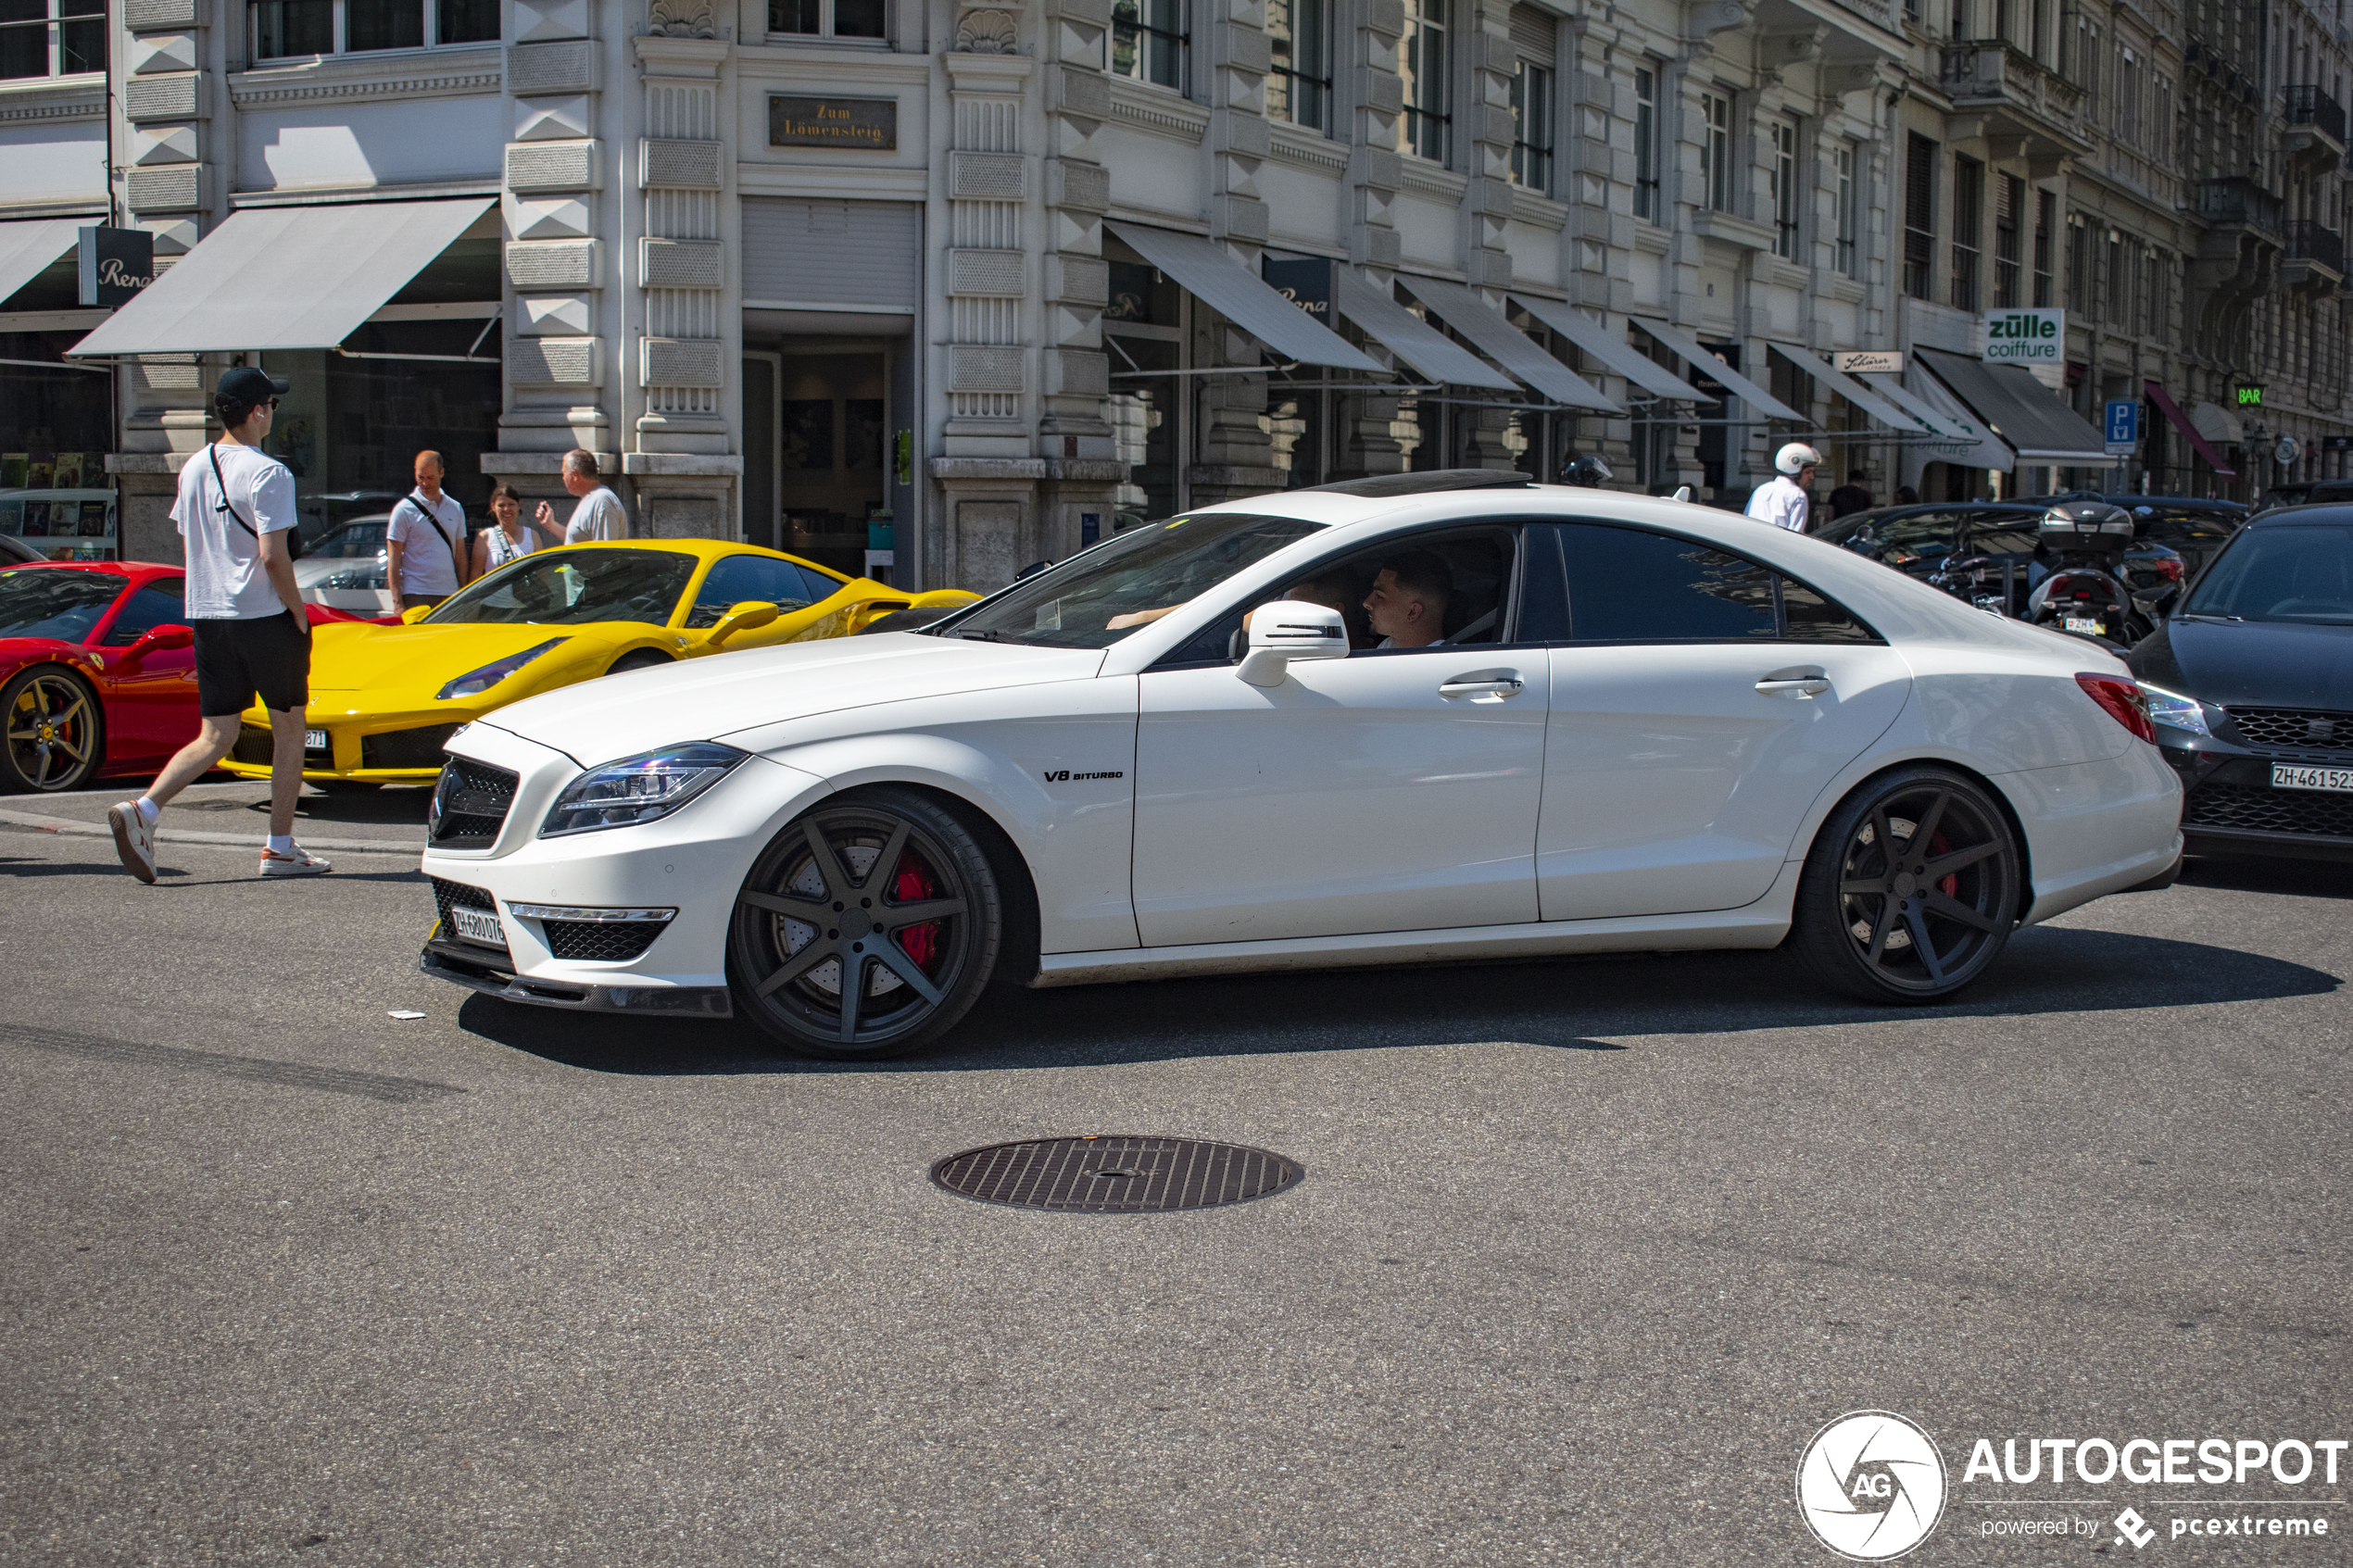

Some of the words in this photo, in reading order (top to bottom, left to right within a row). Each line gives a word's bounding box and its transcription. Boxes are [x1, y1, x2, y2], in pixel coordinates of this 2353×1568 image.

[817, 104, 850, 119] Zum
[1987, 340, 2056, 358] coiffure
[2238, 389, 2260, 404] BAR
[2116, 405, 2129, 425] P
[2075, 620, 2087, 628] ZH
[306, 731, 323, 746] 871
[1044, 770, 1070, 783] V8
[1073, 771, 1124, 781] BITURBO
